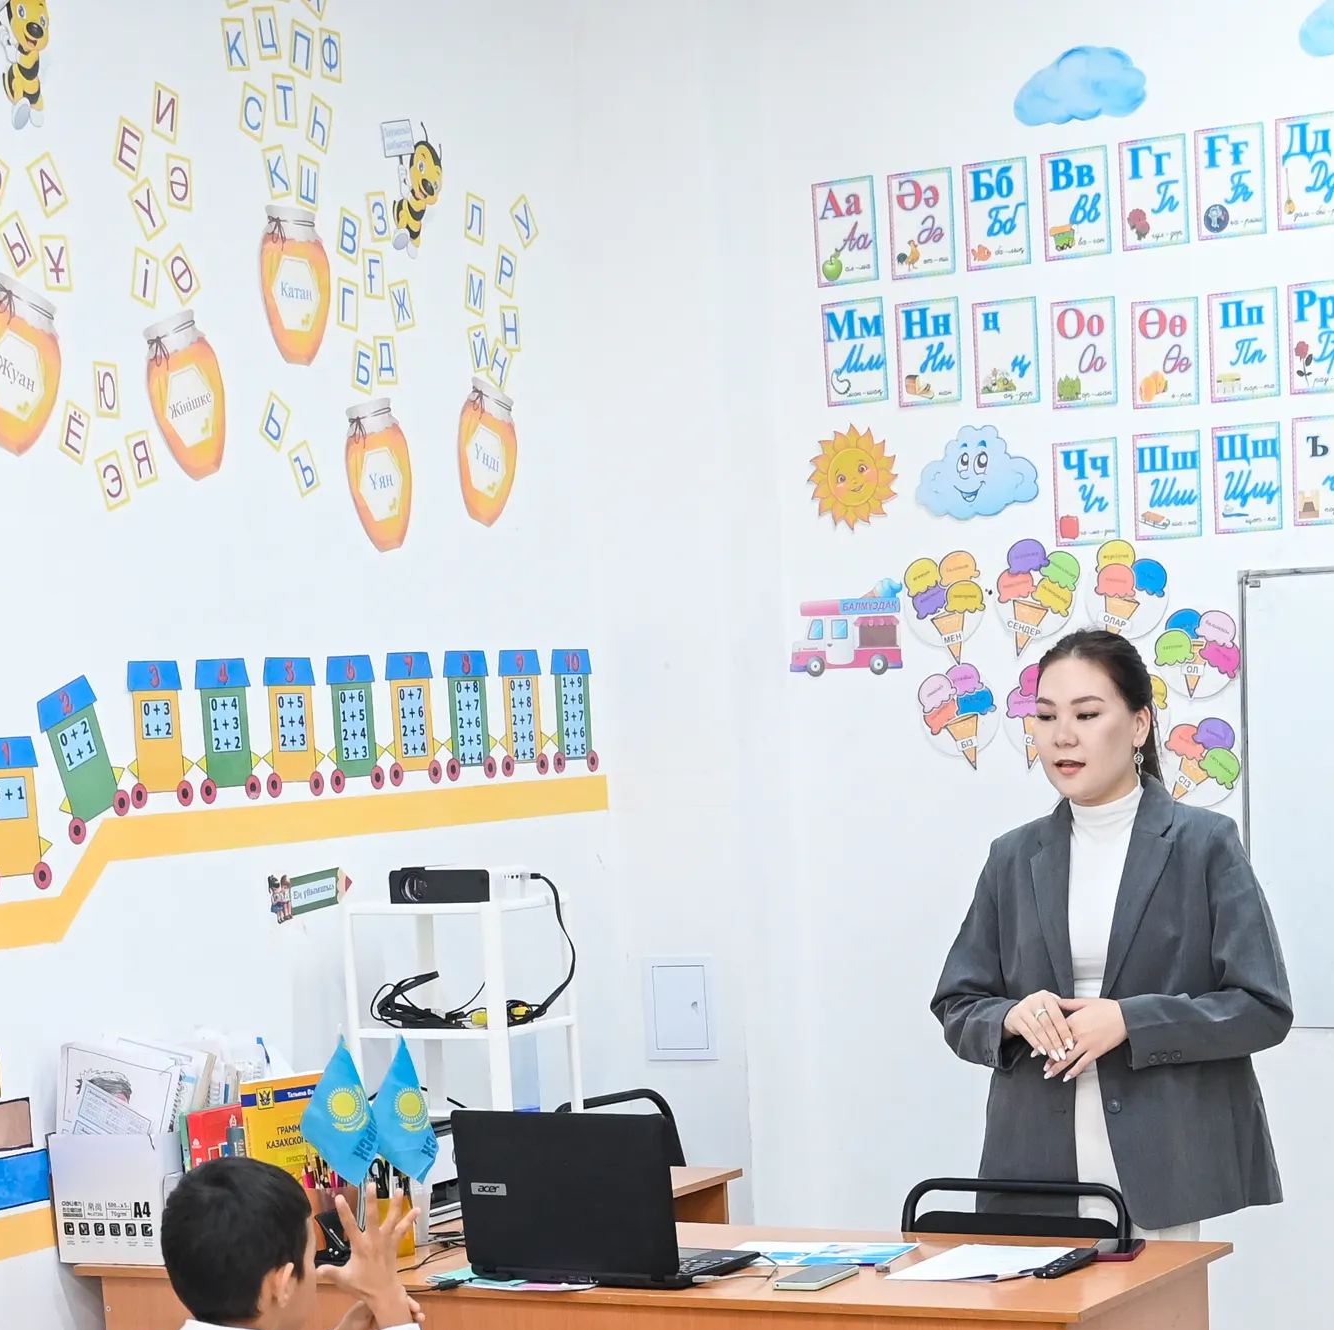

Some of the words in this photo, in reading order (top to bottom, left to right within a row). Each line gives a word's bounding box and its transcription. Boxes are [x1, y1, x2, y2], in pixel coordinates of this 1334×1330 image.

[226, 31, 246, 66] К
[258, 18, 277, 54] Ц
[293, 30, 310, 70] П
[322, 35, 338, 72] Ф
[155, 90, 176, 132] И
[244, 96, 262, 130] С
[276, 85, 292, 121] Т
[118, 126, 140, 171] Е
[1204, 135, 1249, 169] Ғғ
[1282, 122, 1332, 166] Дд
[267, 156, 288, 190] Қ
[1048, 158, 1095, 191] Вв
[1128, 146, 1171, 180] Гг
[39, 168, 62, 207] А
[170, 166, 188, 202] Ә
[300, 166, 316, 204] Ш
[896, 179, 939, 210] Әә
[969, 166, 1014, 202] Бб
[372, 202, 387, 235] З
[468, 204, 482, 235] Л
[819, 188, 862, 220] Аа
[340, 216, 357, 254] В
[515, 204, 530, 240] У
[3, 222, 31, 268] Ы
[44, 246, 64, 283] Ұ
[171, 255, 193, 294] Ө
[367, 258, 380, 293] Ғ
[498, 255, 513, 284] Р
[341, 288, 354, 322] Г
[392, 288, 411, 323] Ж
[468, 274, 482, 309] М
[503, 312, 518, 344] Н
[825, 309, 883, 342] Мм
[903, 307, 952, 340] Нн
[982, 312, 1000, 333] ң
[1057, 308, 1104, 339] Оо
[1139, 308, 1187, 339] Өө
[1219, 300, 1264, 329] Пп
[379, 343, 394, 377] Д
[473, 331, 488, 369] Й
[356, 351, 370, 385] Б
[98, 371, 116, 410] Ю
[65, 411, 84, 455] Ё
[1216, 433, 1280, 466] Щщ
[133, 440, 152, 479] Я
[1060, 449, 1110, 480] Чч
[1137, 445, 1199, 473] Шш
[103, 464, 122, 498] Э
[1008, 621, 1041, 636] СЕНДЕР
[1103, 615, 1126, 627] ОЛАР
[944, 634, 962, 644] МЕН
[149, 664, 160, 687] 3
[218, 662, 229, 685] 4
[346, 659, 355, 680] 6
[404, 655, 413, 676] 7
[461, 653, 471, 674] 8
[516, 654, 524, 672] 9
[565, 653, 580, 672] 10
[59, 691, 73, 715] 2
[144, 703, 150, 716] 0
[163, 702, 170, 715] 3
[145, 724, 150, 736] 1
[165, 723, 172, 736] 2
[961, 739, 973, 748] БІЗ
[1, 741, 10, 765] 1
[18, 786, 24, 800] 1
[1179, 776, 1191, 788] СІЗ
[134, 1202, 151, 1218] A4
